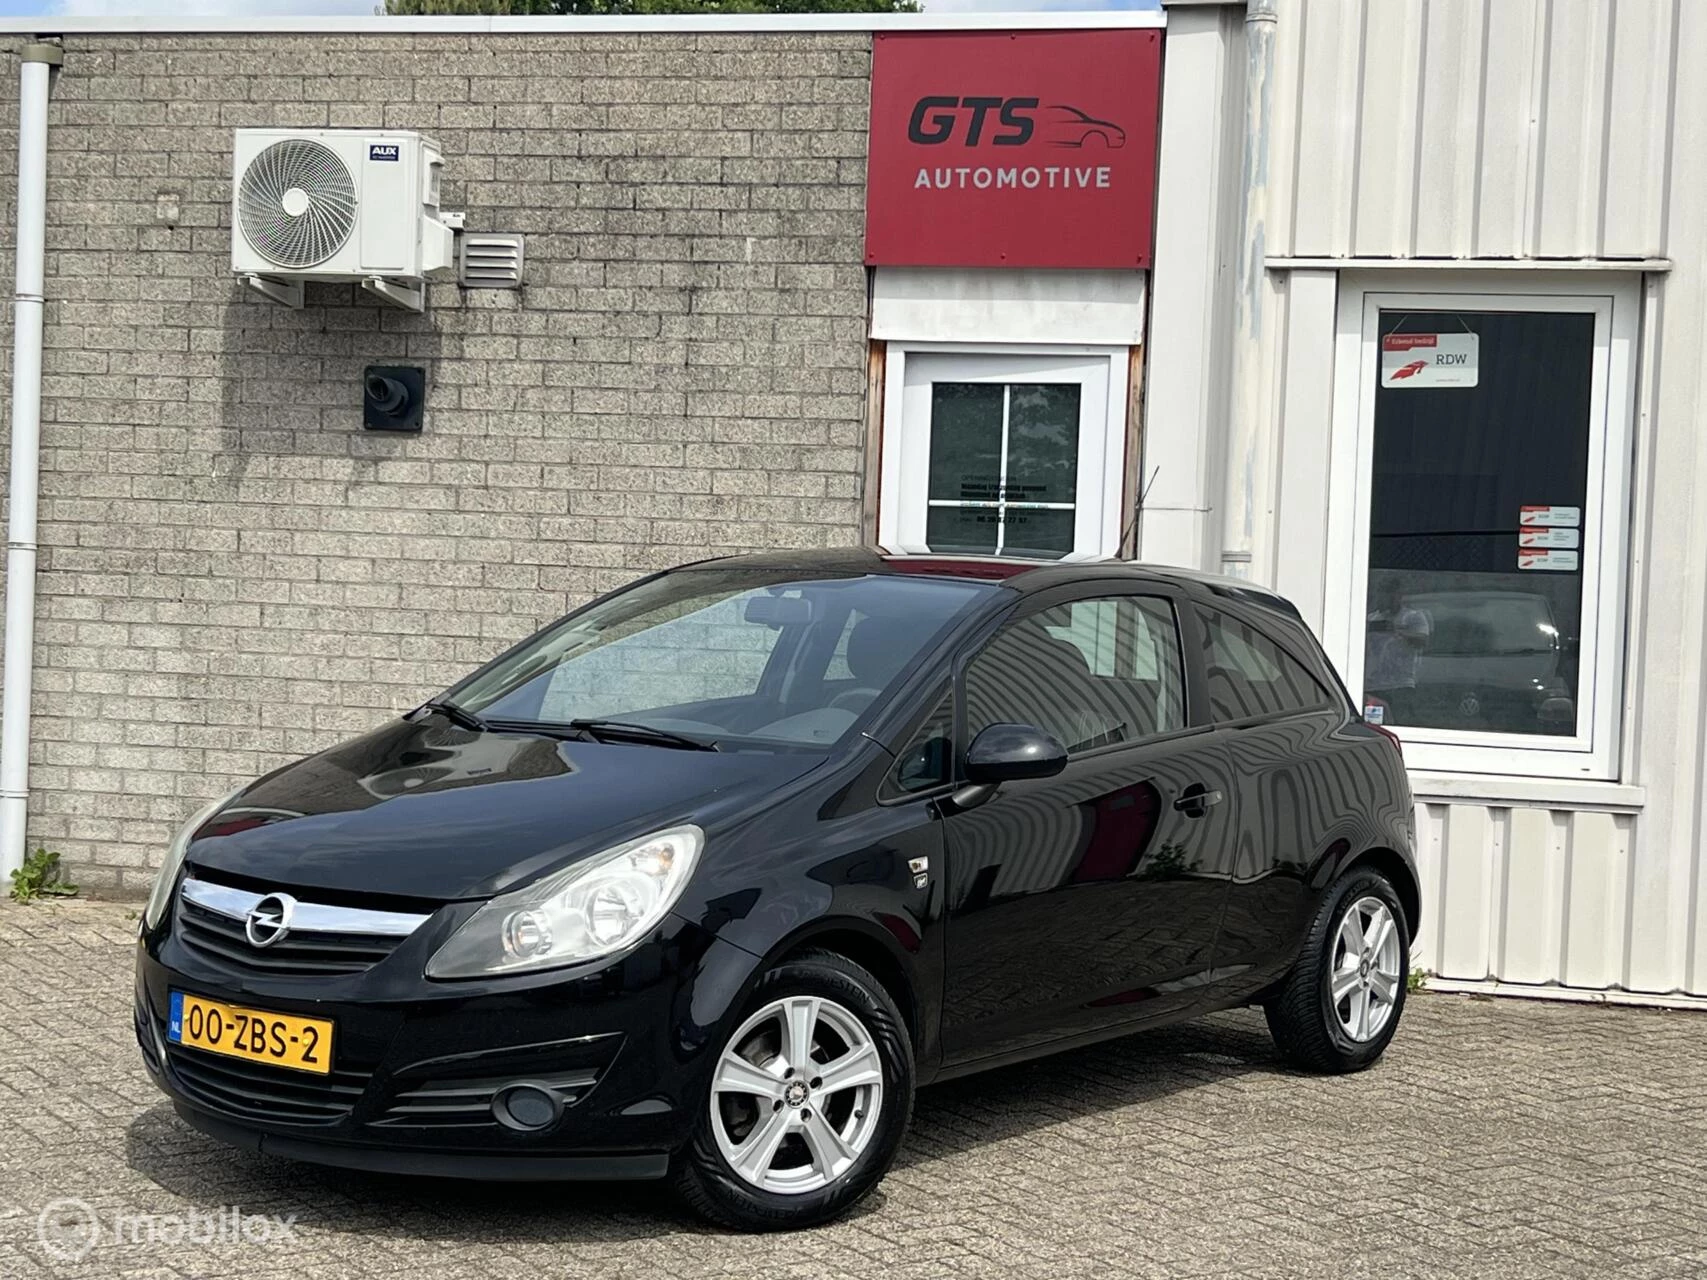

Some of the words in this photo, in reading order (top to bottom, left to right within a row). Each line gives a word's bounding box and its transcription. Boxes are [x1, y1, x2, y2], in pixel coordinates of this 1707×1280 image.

[908, 96, 1039, 146] GTS
[372, 146, 397, 155] AUX
[914, 167, 1111, 188] AUTOMOTIVE
[1436, 354, 1467, 365] RDW
[171, 1021, 181, 1033] NL
[189, 1004, 319, 1064] 00-ZBS-2
